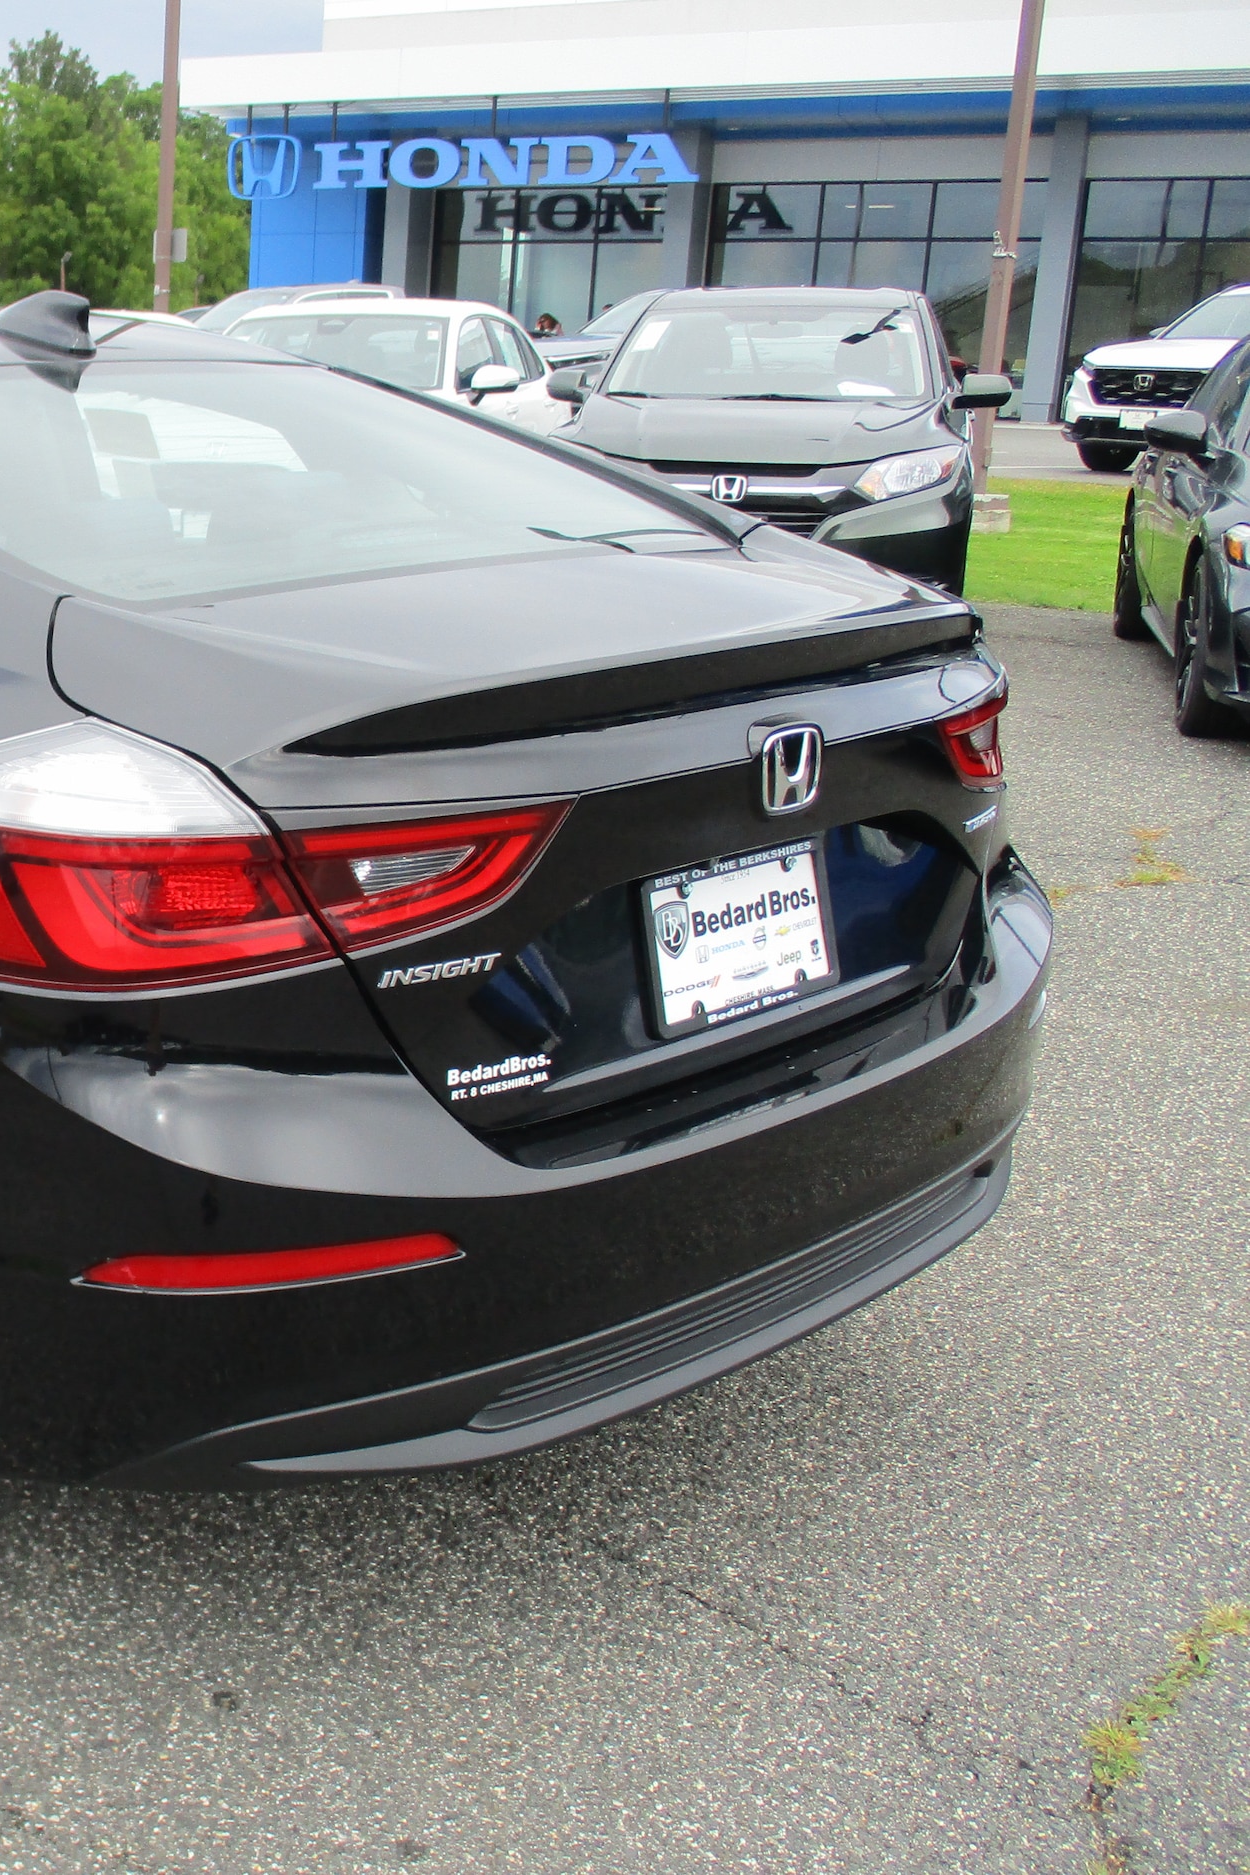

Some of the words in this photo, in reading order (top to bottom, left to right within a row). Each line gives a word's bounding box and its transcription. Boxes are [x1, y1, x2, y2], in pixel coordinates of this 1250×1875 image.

[312, 133, 700, 190] HONDA
[654, 872, 688, 888] BEST
[712, 859, 737, 874] THE
[738, 841, 812, 867] BERKSHIRES
[691, 893, 767, 937] Bedard
[768, 887, 816, 916] Bros.
[711, 940, 747, 955] HONDA
[776, 950, 802, 967] Jeep
[377, 952, 502, 989] INSIGHT
[663, 979, 715, 998] DODGE
[707, 1000, 759, 1024] Bedard
[761, 990, 798, 1007] Bros.
[451, 1089, 468, 1101] RT.
[470, 1086, 478, 1098] 8
